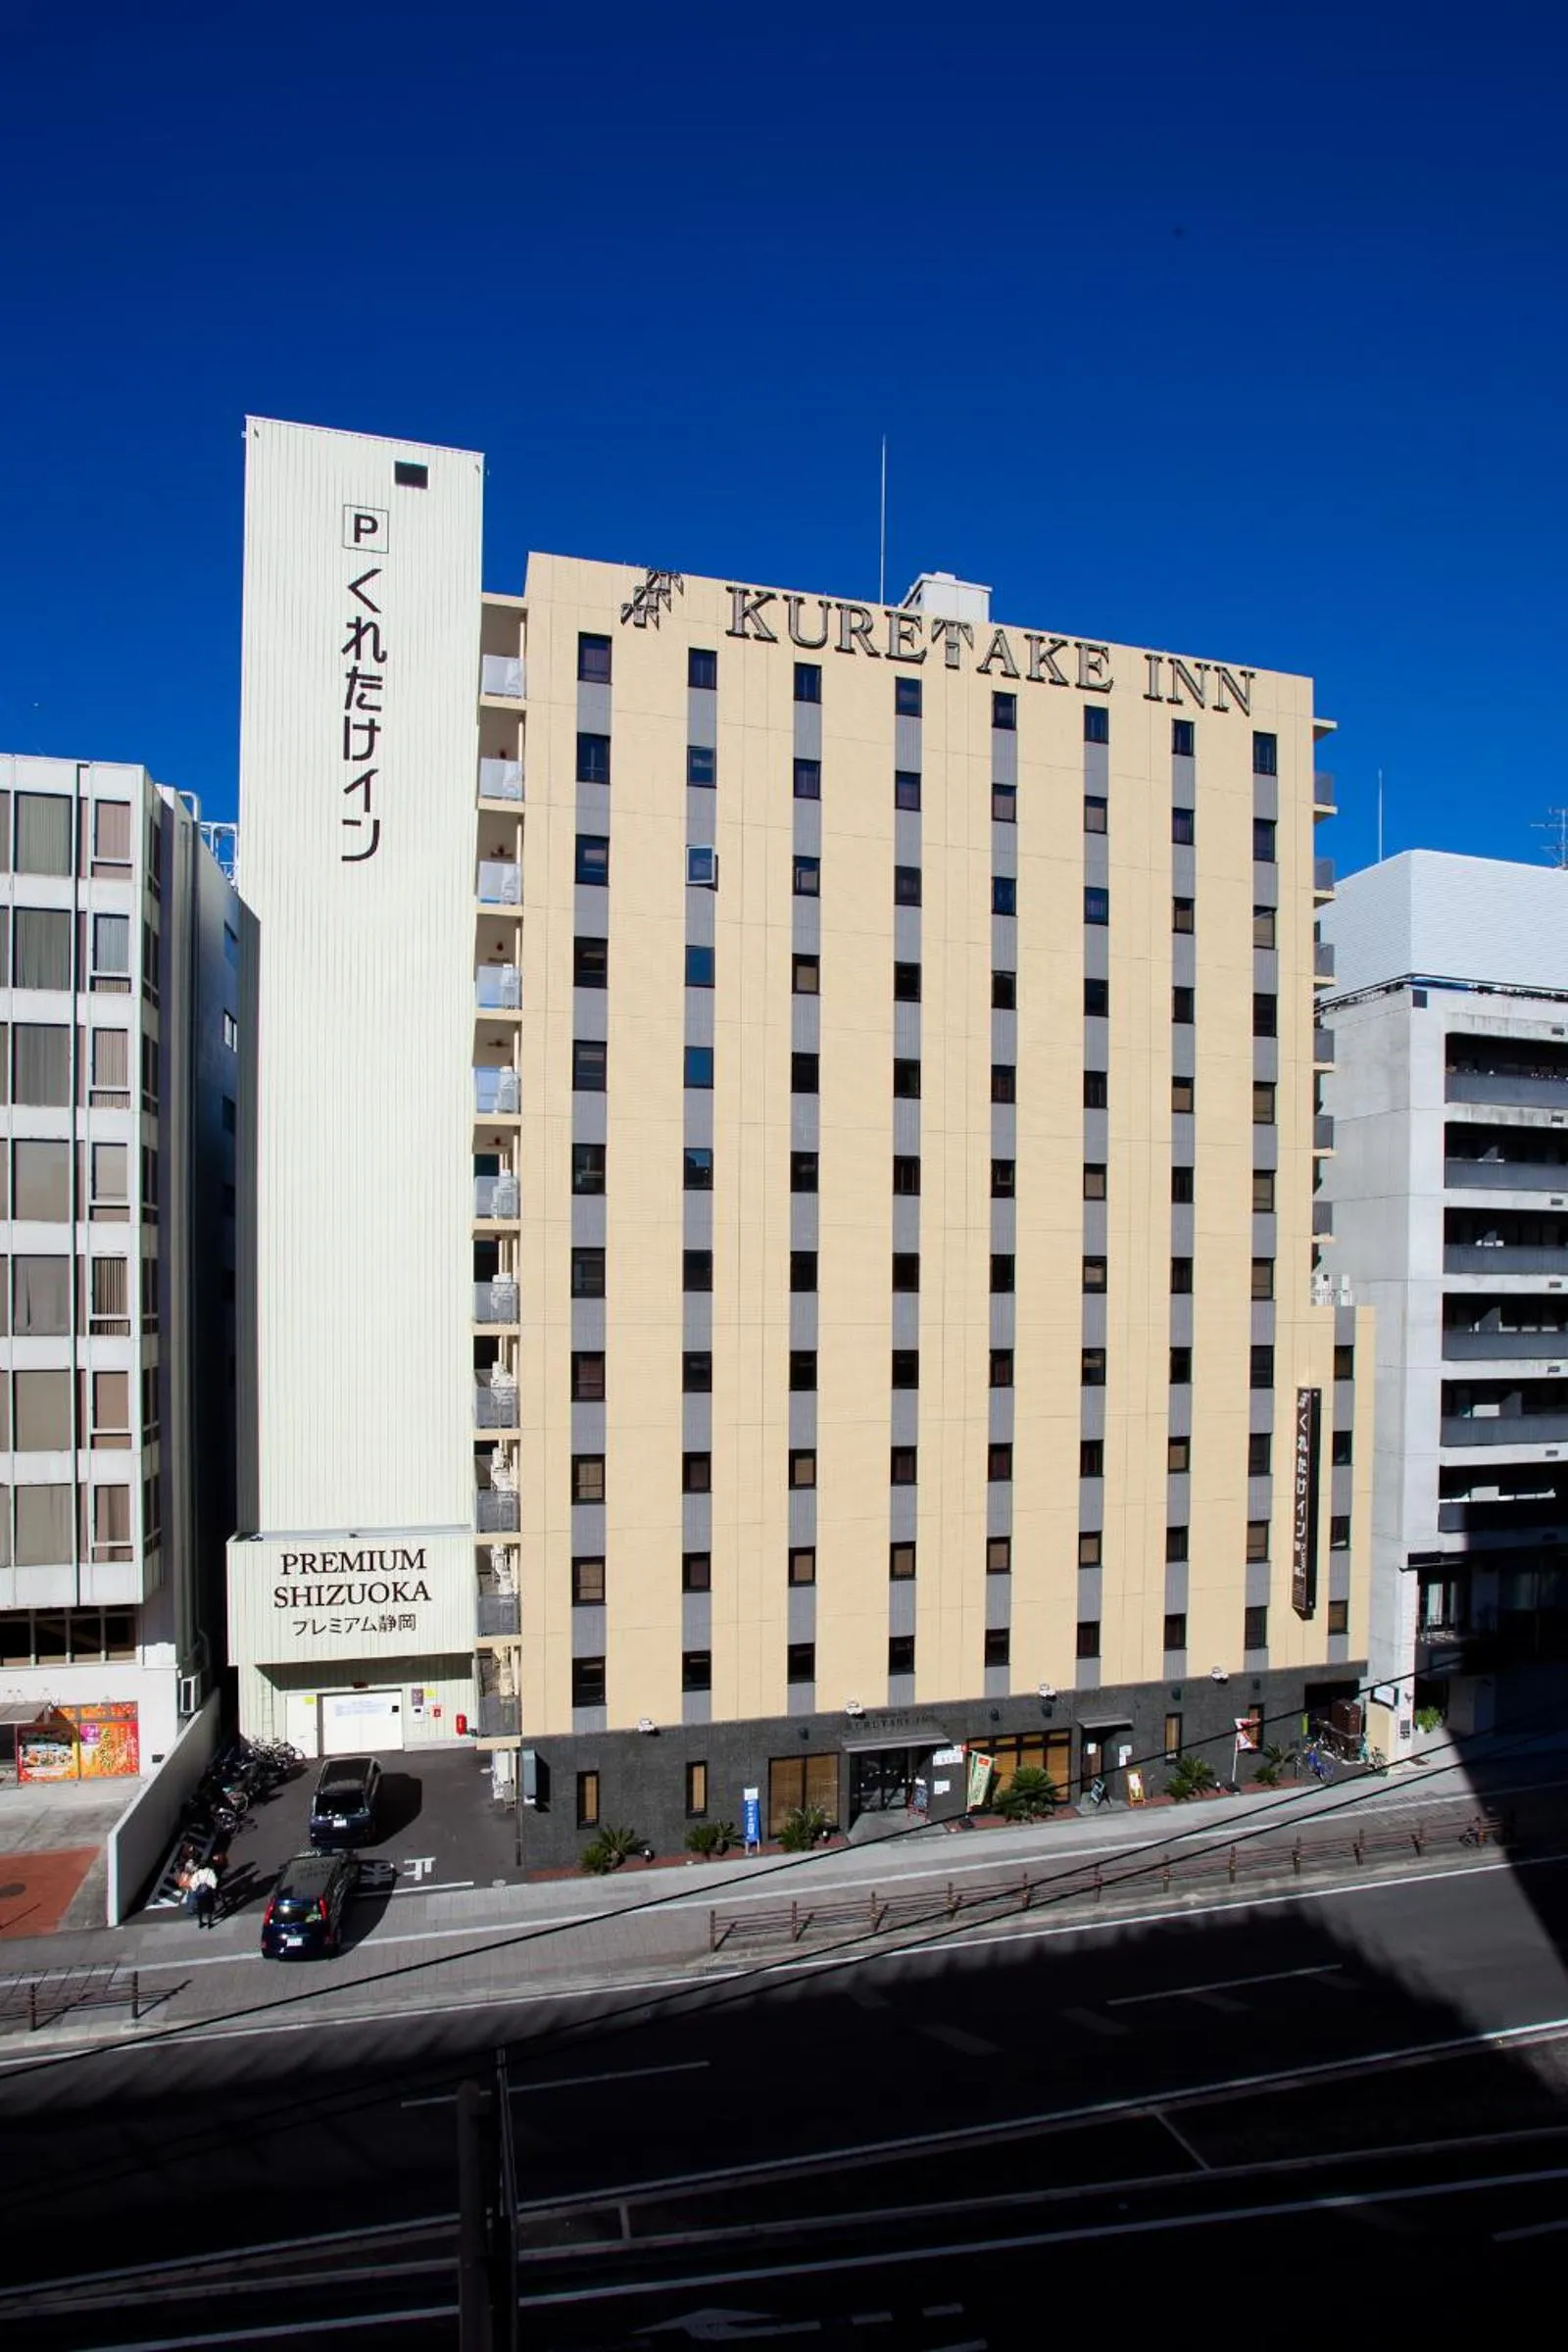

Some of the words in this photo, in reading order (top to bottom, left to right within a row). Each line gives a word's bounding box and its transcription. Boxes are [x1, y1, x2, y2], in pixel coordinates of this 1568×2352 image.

[353, 514, 378, 544] P
[725, 585, 1114, 693] KURETAKE
[1143, 652, 1255, 717] INN
[341, 567, 387, 862] くれたけイン
[280, 1548, 427, 1575] PREMIUM
[273, 1581, 432, 1608] SHIZUOKA
[292, 1613, 416, 1637] プレミアム静岡
